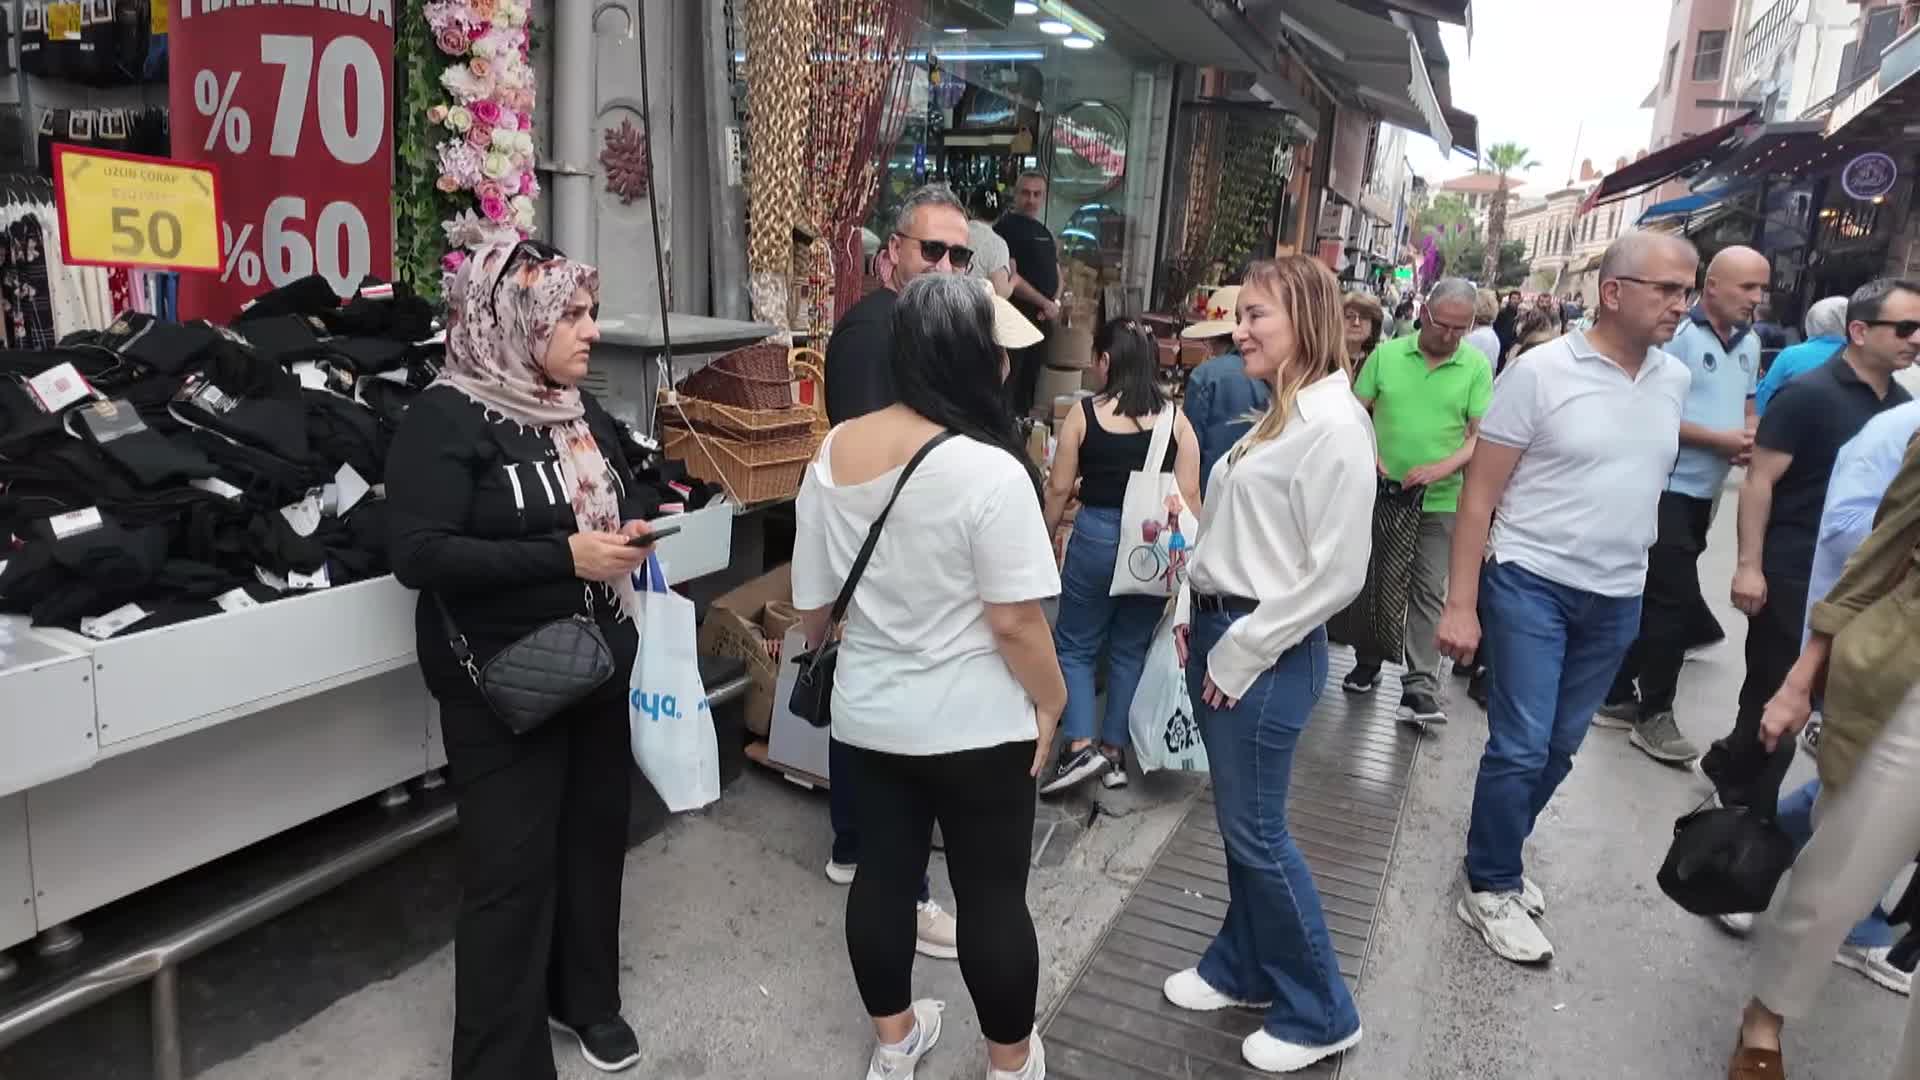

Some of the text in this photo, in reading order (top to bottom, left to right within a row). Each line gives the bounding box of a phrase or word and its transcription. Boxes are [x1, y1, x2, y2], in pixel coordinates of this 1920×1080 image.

[194, 34, 385, 164] %70
[112, 207, 183, 259] 50
[222, 196, 371, 299] %60
